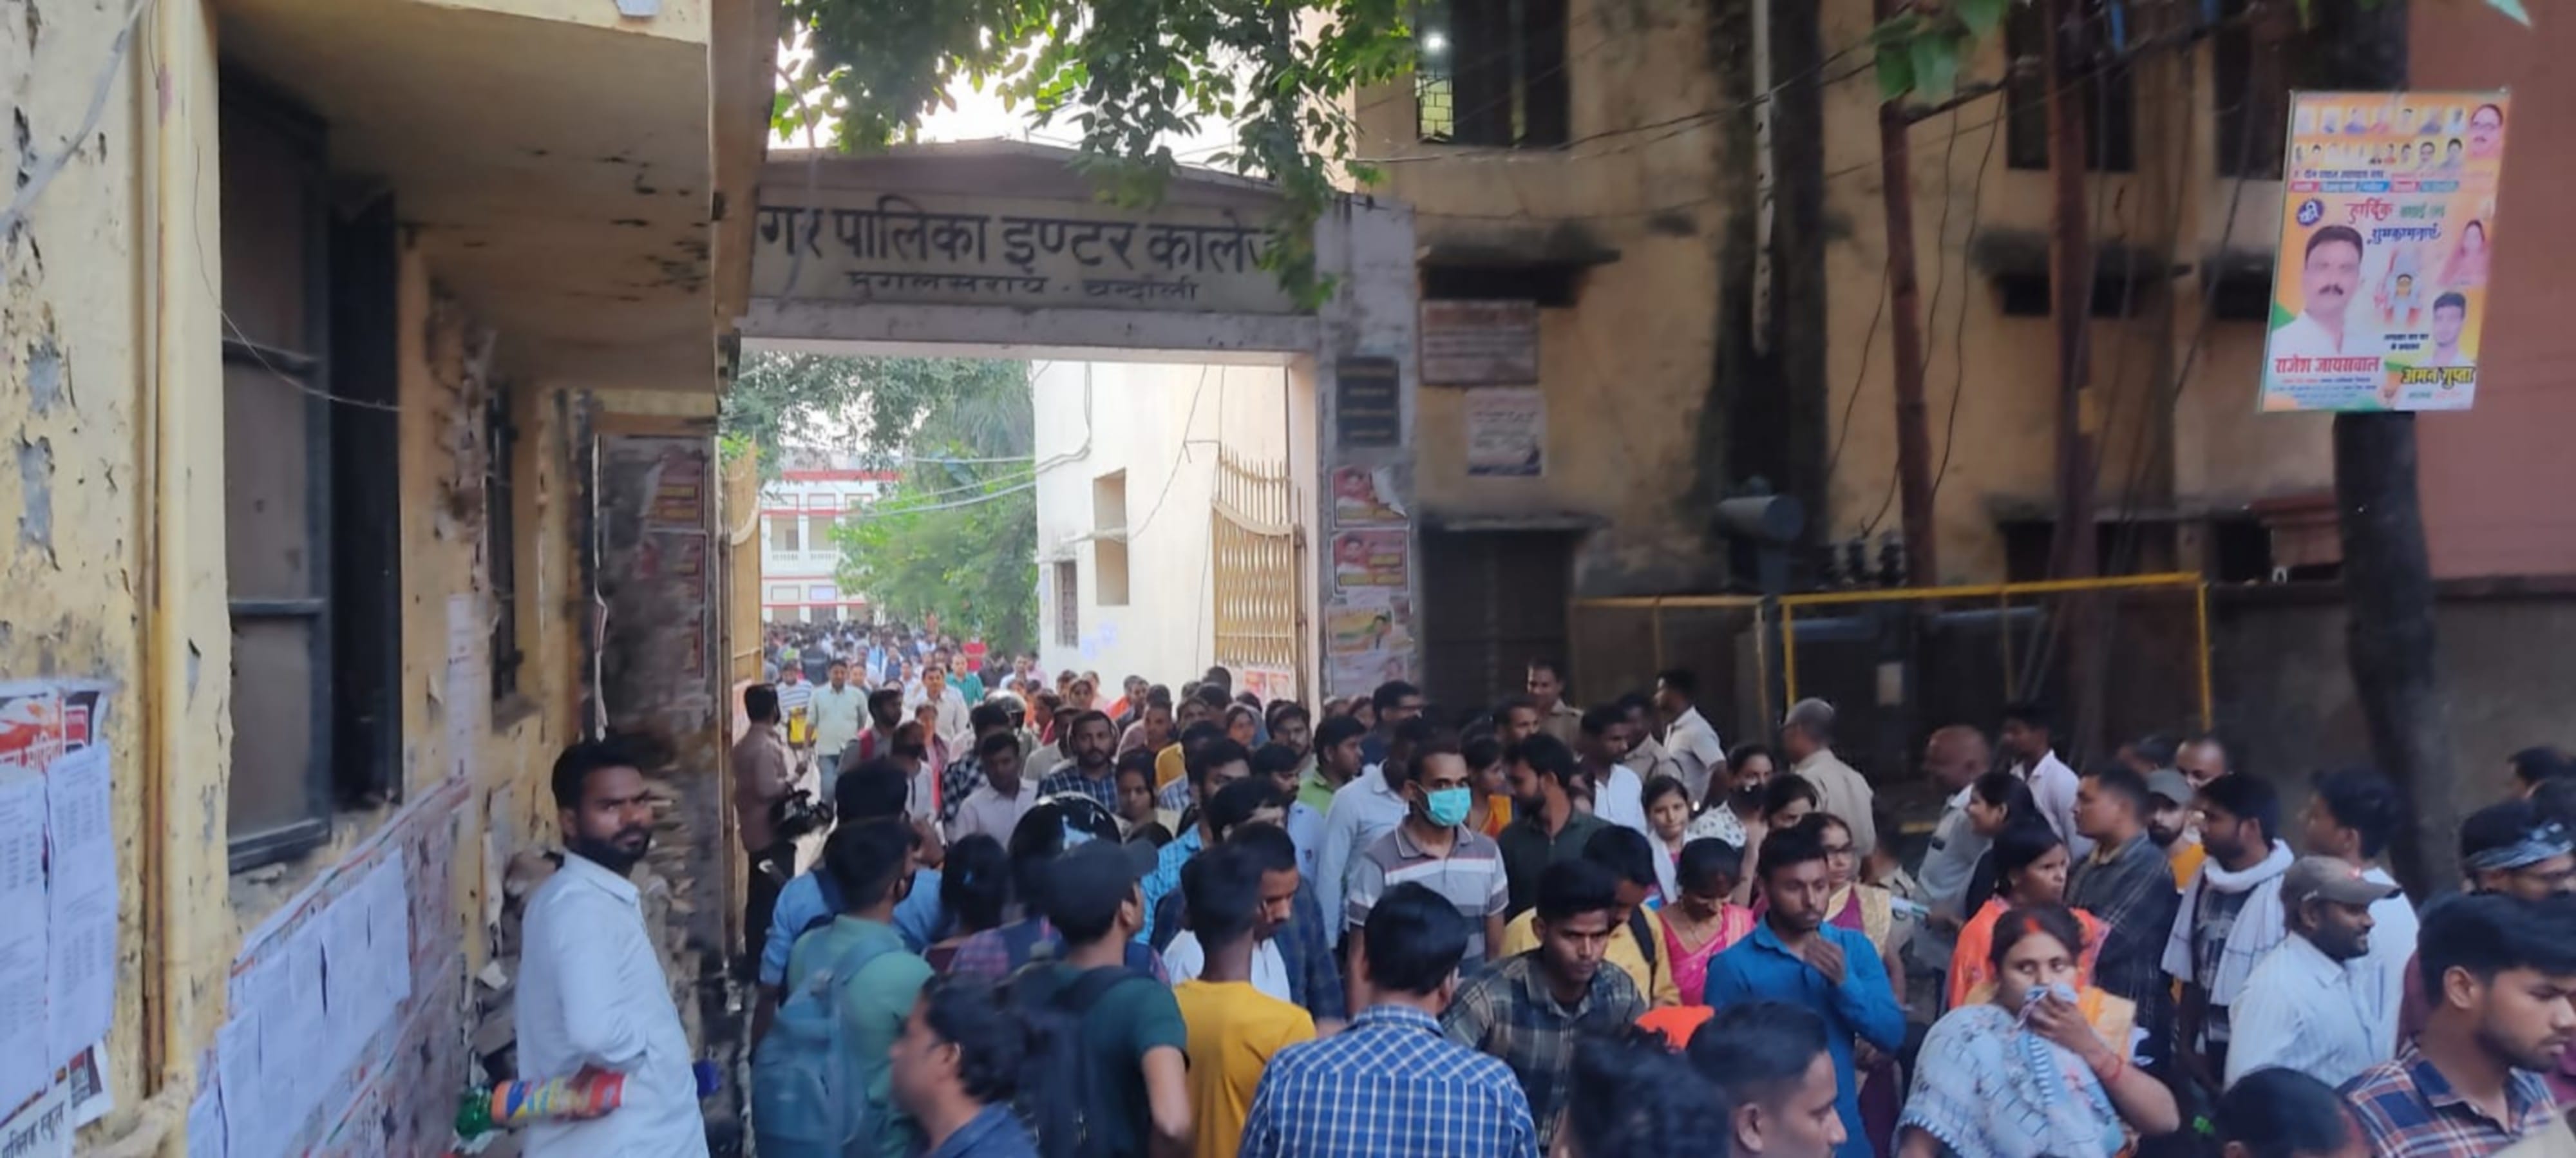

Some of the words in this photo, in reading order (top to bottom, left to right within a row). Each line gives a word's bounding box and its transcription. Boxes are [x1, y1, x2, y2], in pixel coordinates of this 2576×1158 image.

[831, 195, 990, 262] पालिका
[1001, 216, 1137, 274] इण्टर
[2275, 354, 2311, 374] राजेश
[2315, 356, 2381, 374] जायसवाल
[2401, 366, 2439, 384] अमन
[2439, 366, 2476, 390] गुप्ता
